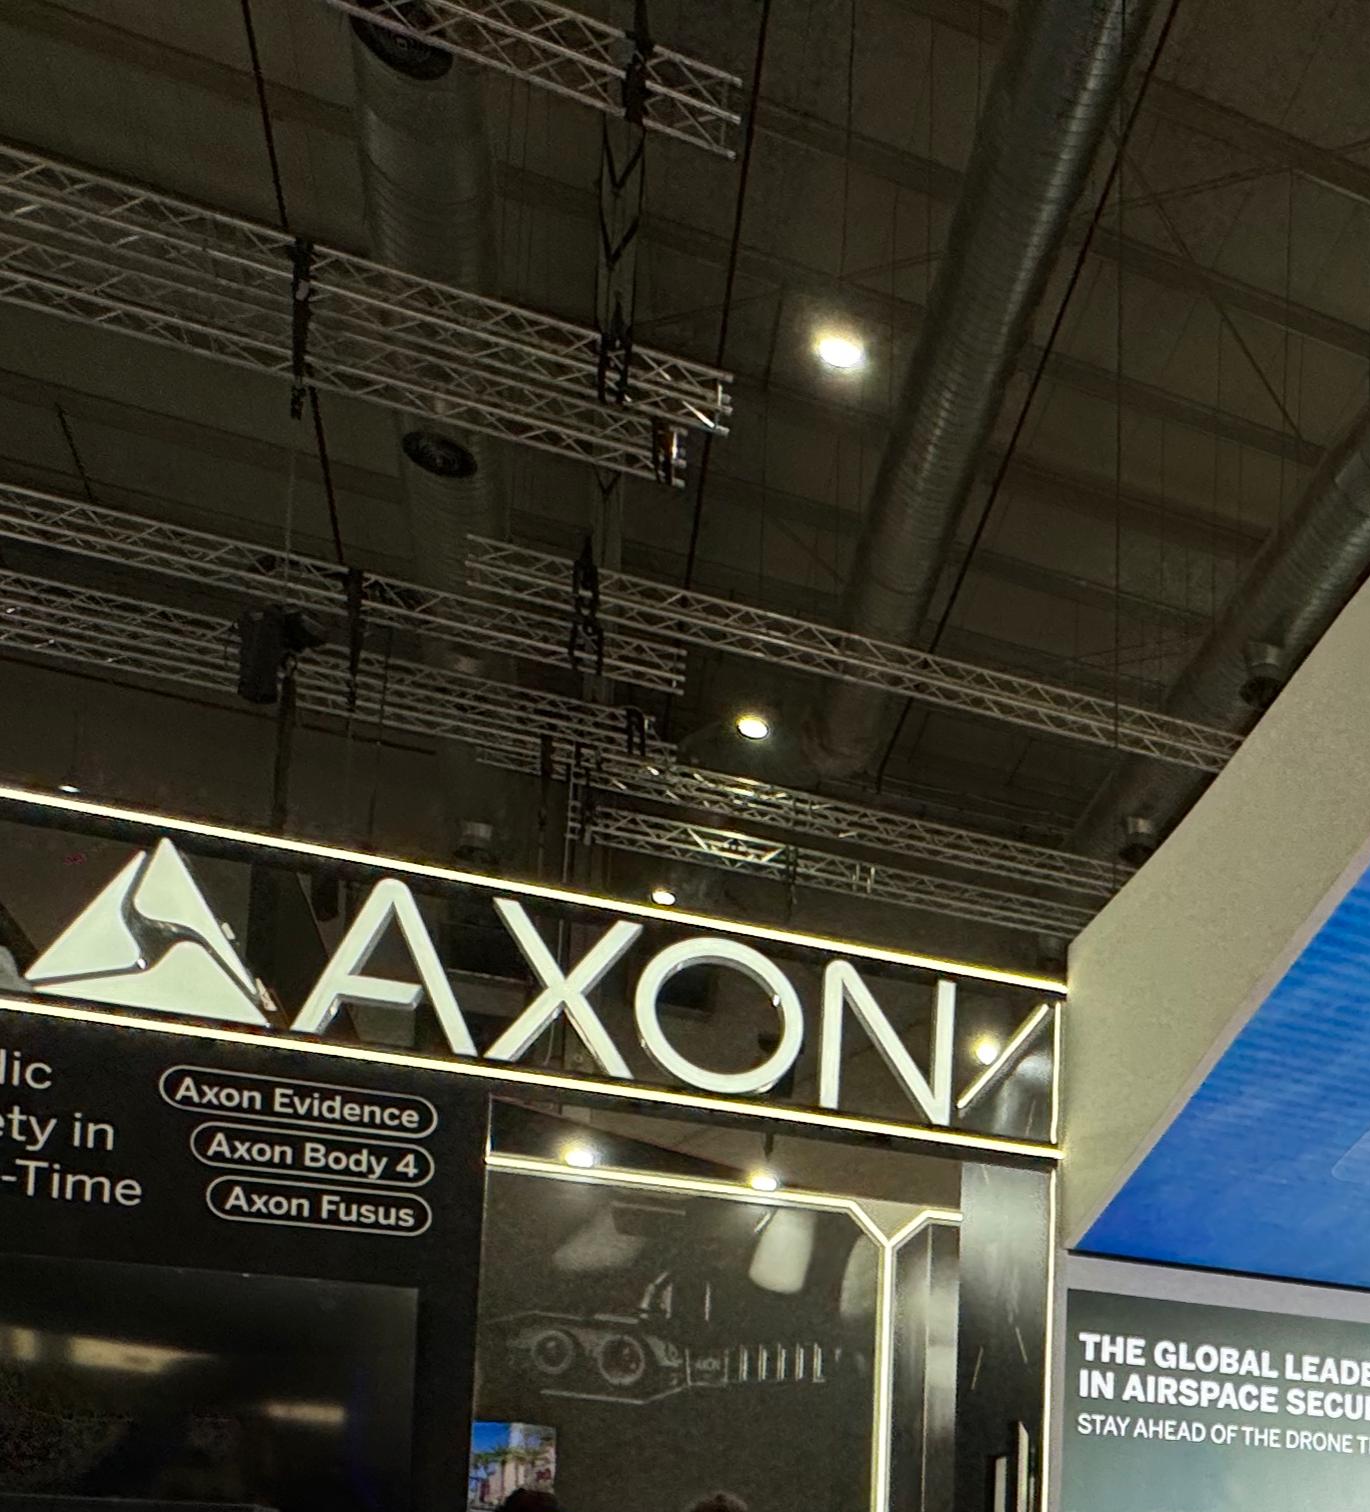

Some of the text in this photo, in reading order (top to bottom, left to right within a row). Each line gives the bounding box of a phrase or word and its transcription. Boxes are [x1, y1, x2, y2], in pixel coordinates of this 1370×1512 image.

[289, 877, 957, 1126] AXON
[174, 1076, 420, 1129] Axon Evidence
[0, 1104, 115, 1151] ty in
[206, 1131, 418, 1181] Axon Body 4
[224, 1185, 416, 1228] Axon Fusus
[1078, 1331, 1147, 1367] THE
[1153, 1339, 1279, 1379] GLOBAL
[1079, 1367, 1115, 1401] IN
[1121, 1372, 1280, 1414] AIRSPACE
[1076, 1412, 1131, 1438] STAY
[1132, 1417, 1207, 1443] AHEAD
[1209, 1422, 1239, 1446] OF
[1240, 1425, 1282, 1449] THE
[1285, 1429, 1354, 1454] DRONE
